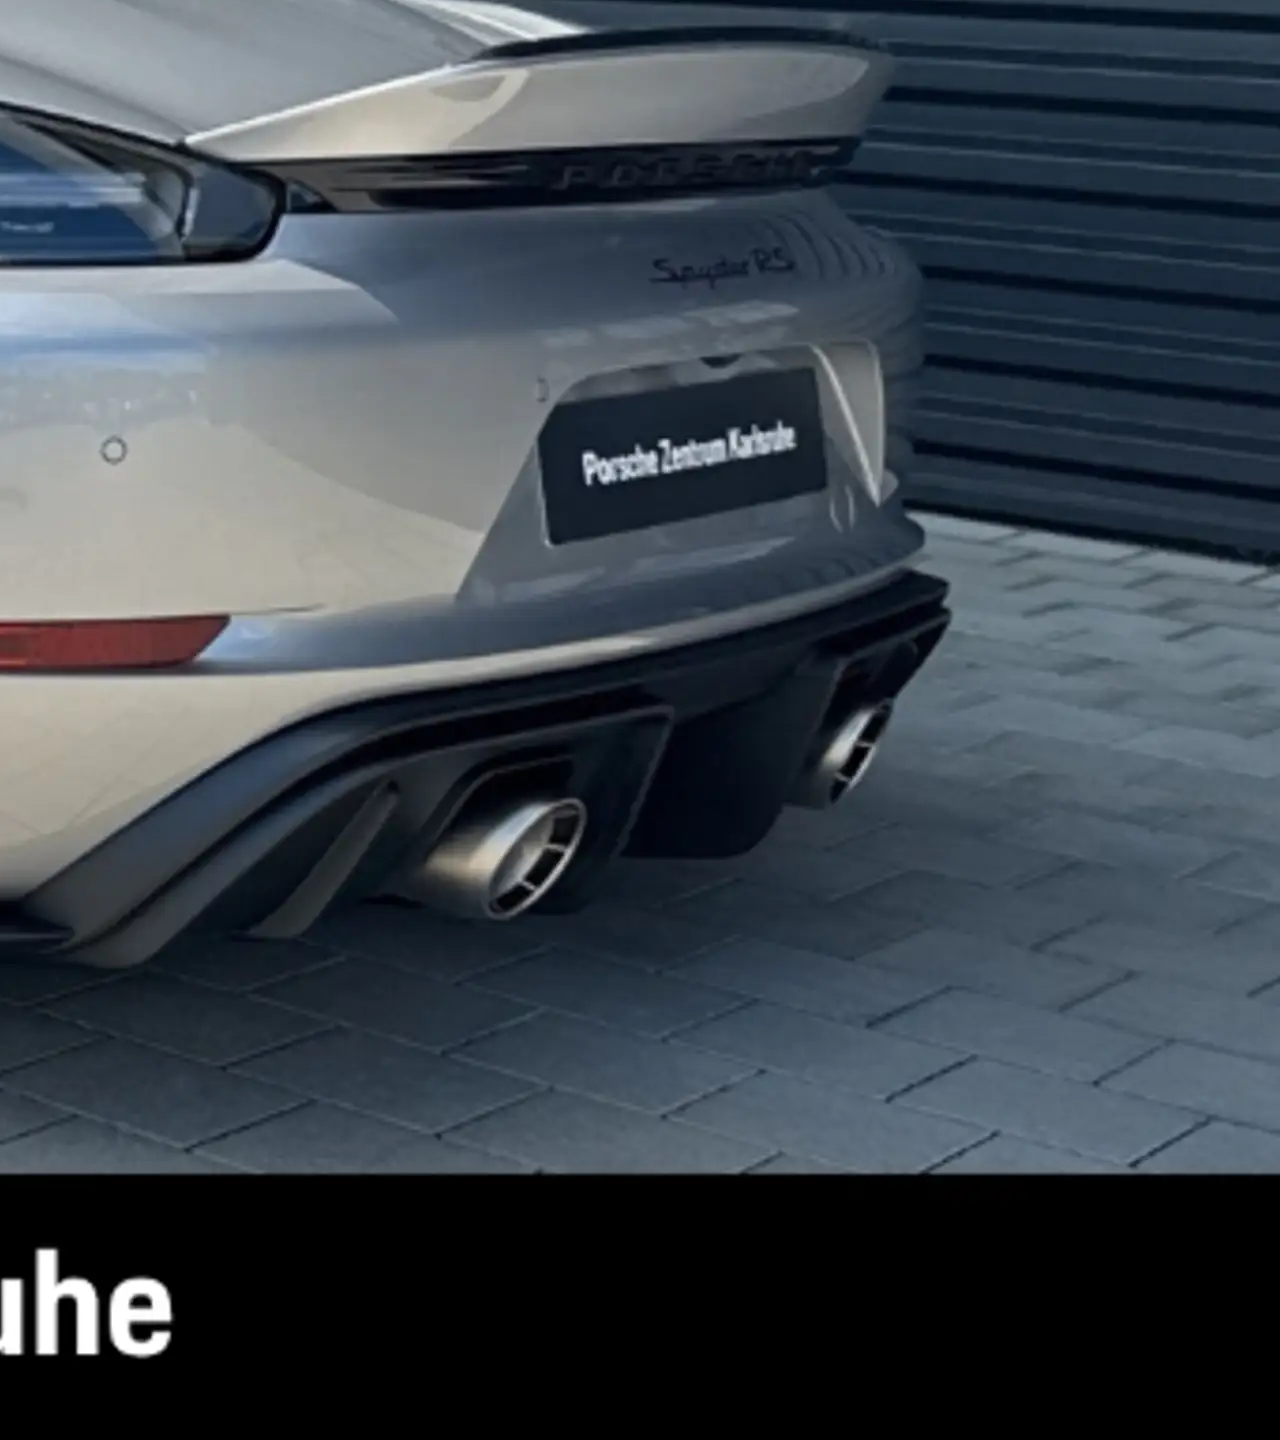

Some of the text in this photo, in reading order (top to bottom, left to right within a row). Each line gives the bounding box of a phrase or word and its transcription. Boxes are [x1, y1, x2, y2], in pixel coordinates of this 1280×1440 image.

[648, 246, 797, 290] Spyder RS
[582, 420, 797, 486] Porsche Zentrum Karlsruhe
